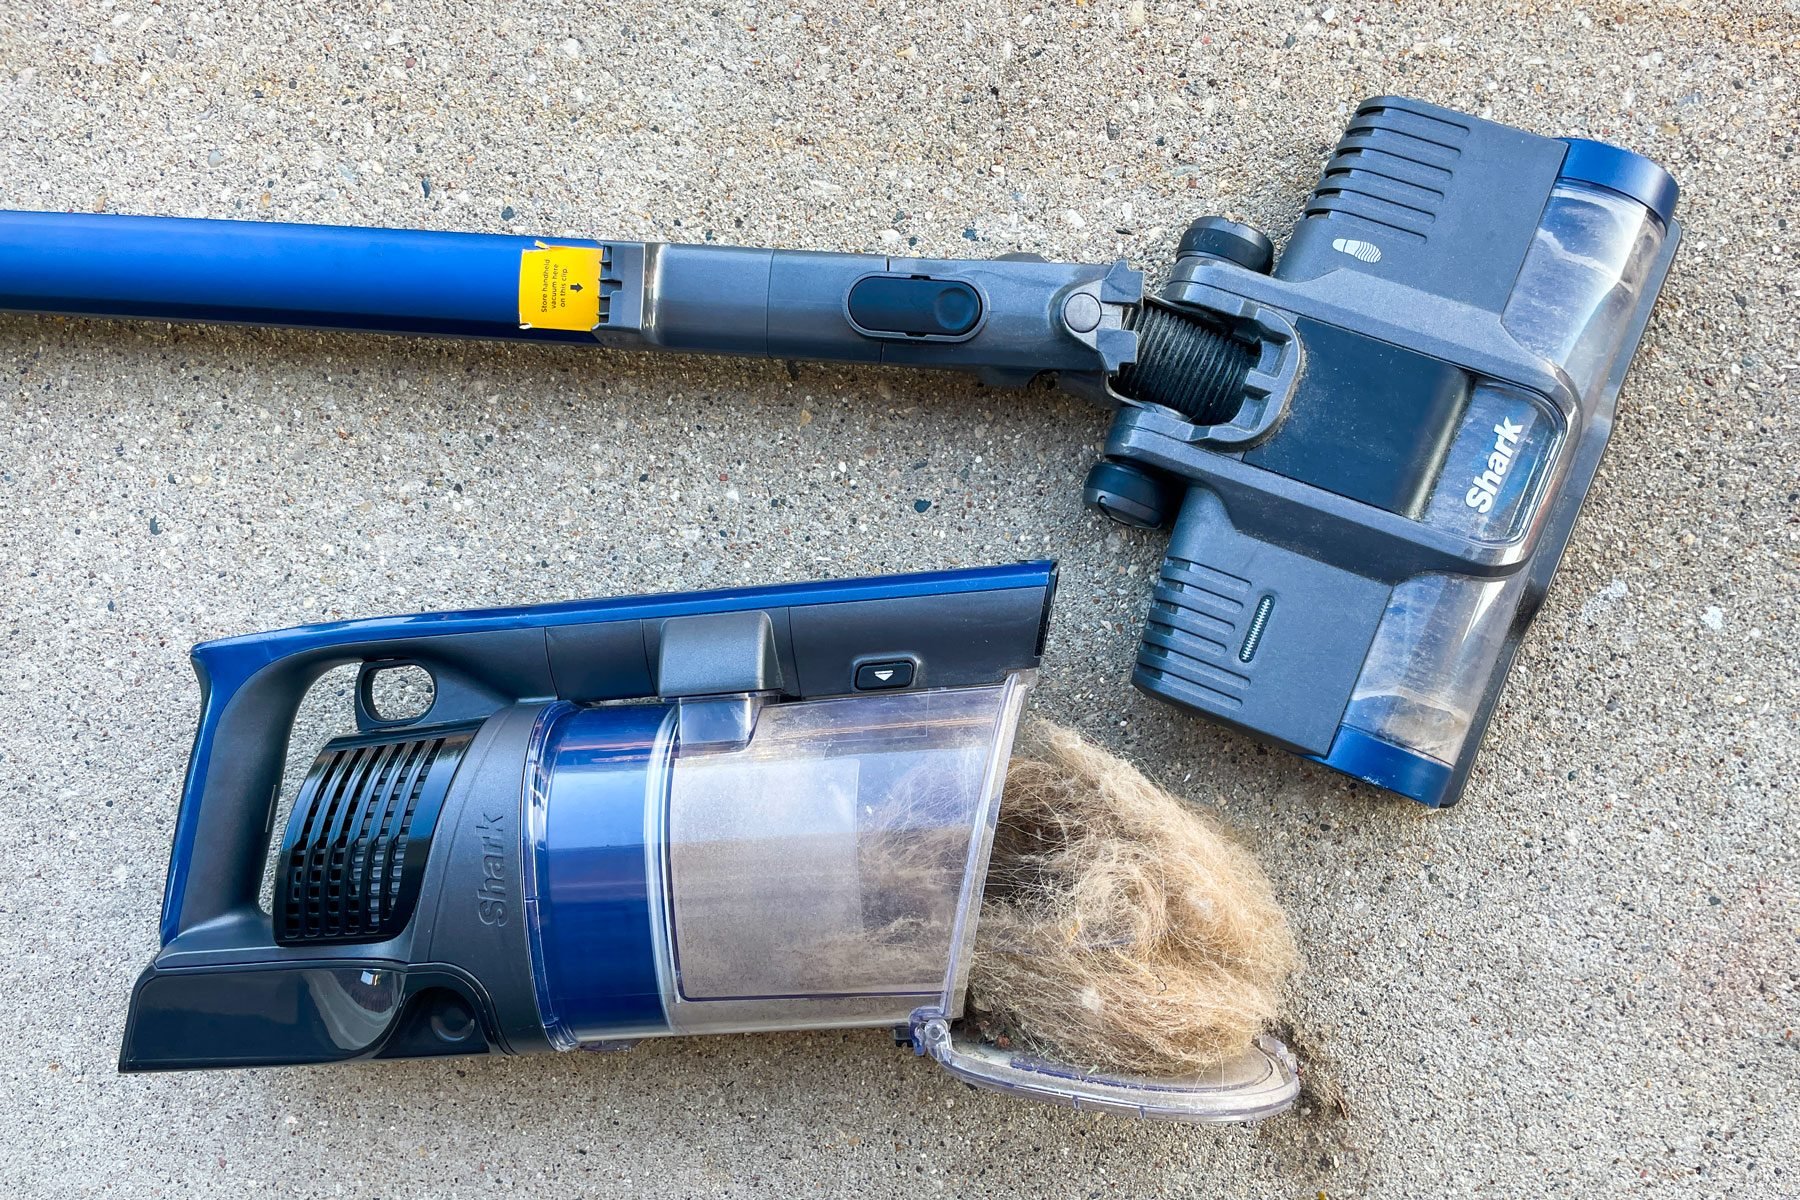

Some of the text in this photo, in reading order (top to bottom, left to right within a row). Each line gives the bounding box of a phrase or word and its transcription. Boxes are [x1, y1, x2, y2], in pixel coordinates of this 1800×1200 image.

[541, 259, 550, 291] handheld
[1465, 416, 1524, 513] Shark
[475, 812, 509, 927] Shark
